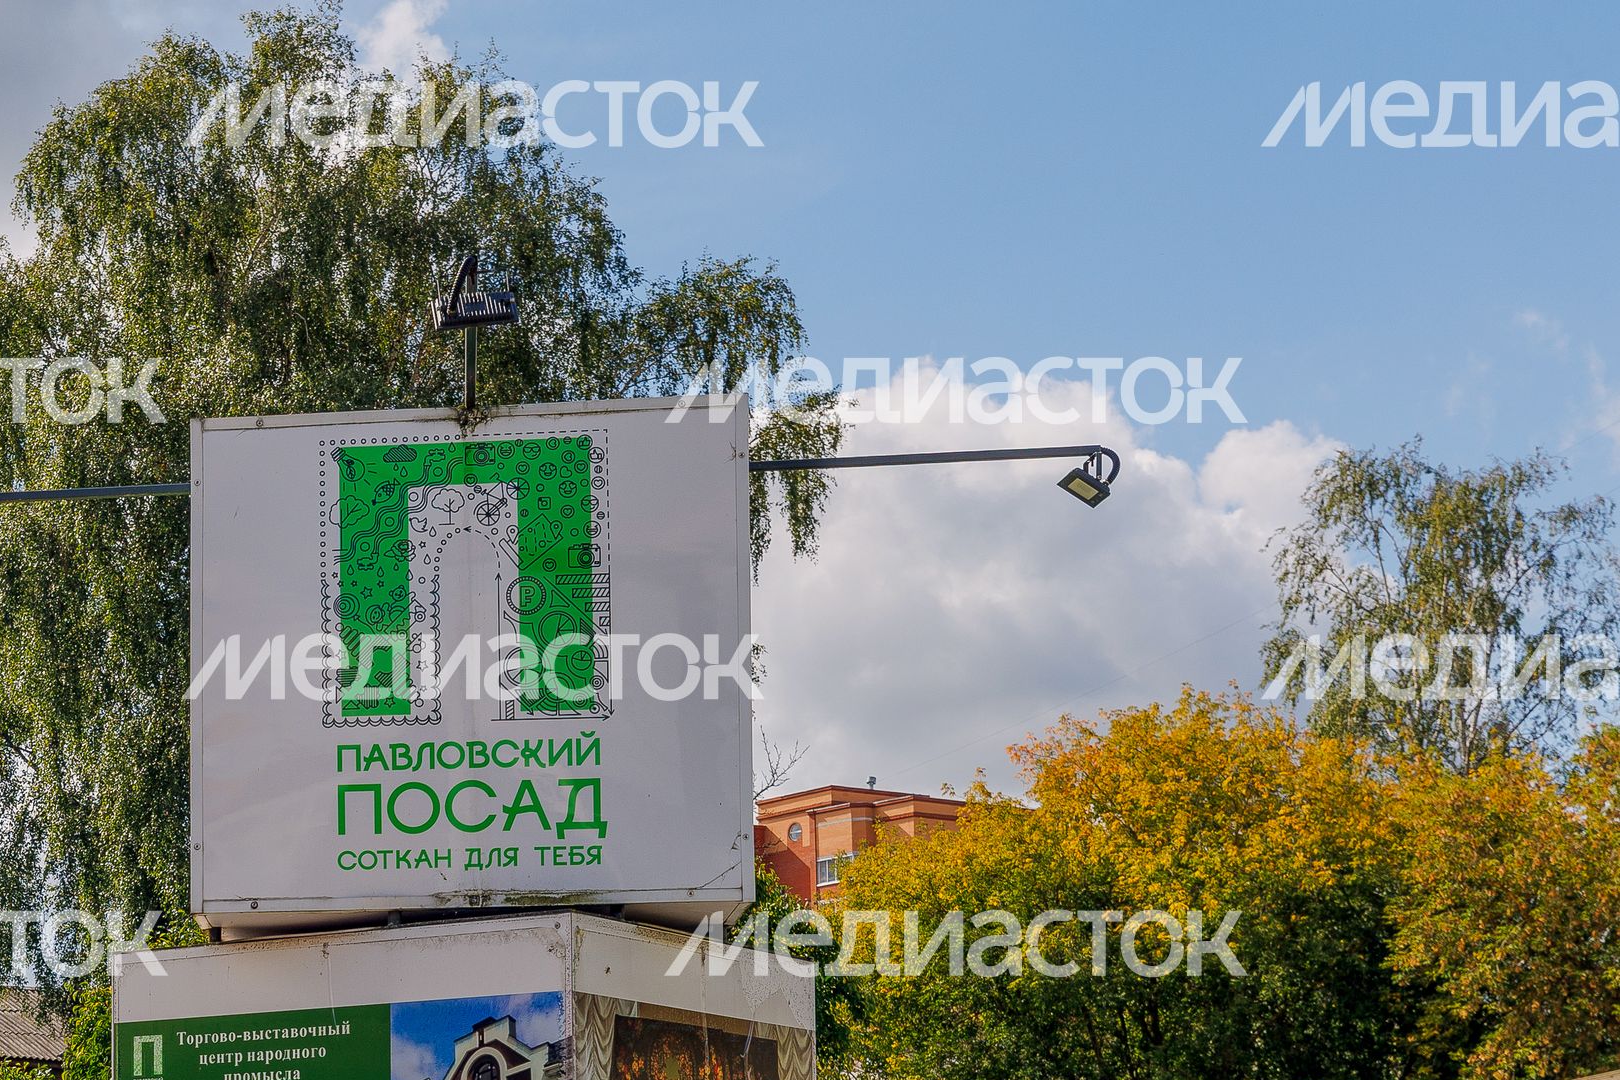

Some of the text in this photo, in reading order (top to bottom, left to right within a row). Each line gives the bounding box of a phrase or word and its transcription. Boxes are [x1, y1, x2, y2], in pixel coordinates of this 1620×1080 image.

[337, 731, 601, 772] ПАВЛОВСКИЙ
[337, 778, 608, 840] ПОСАД
[337, 845, 602, 871] СОТКАН ДЛЯ ТЕБЯ
[177, 1021, 351, 1048] Торгово-выставочный
[199, 1046, 327, 1067] центр народного
